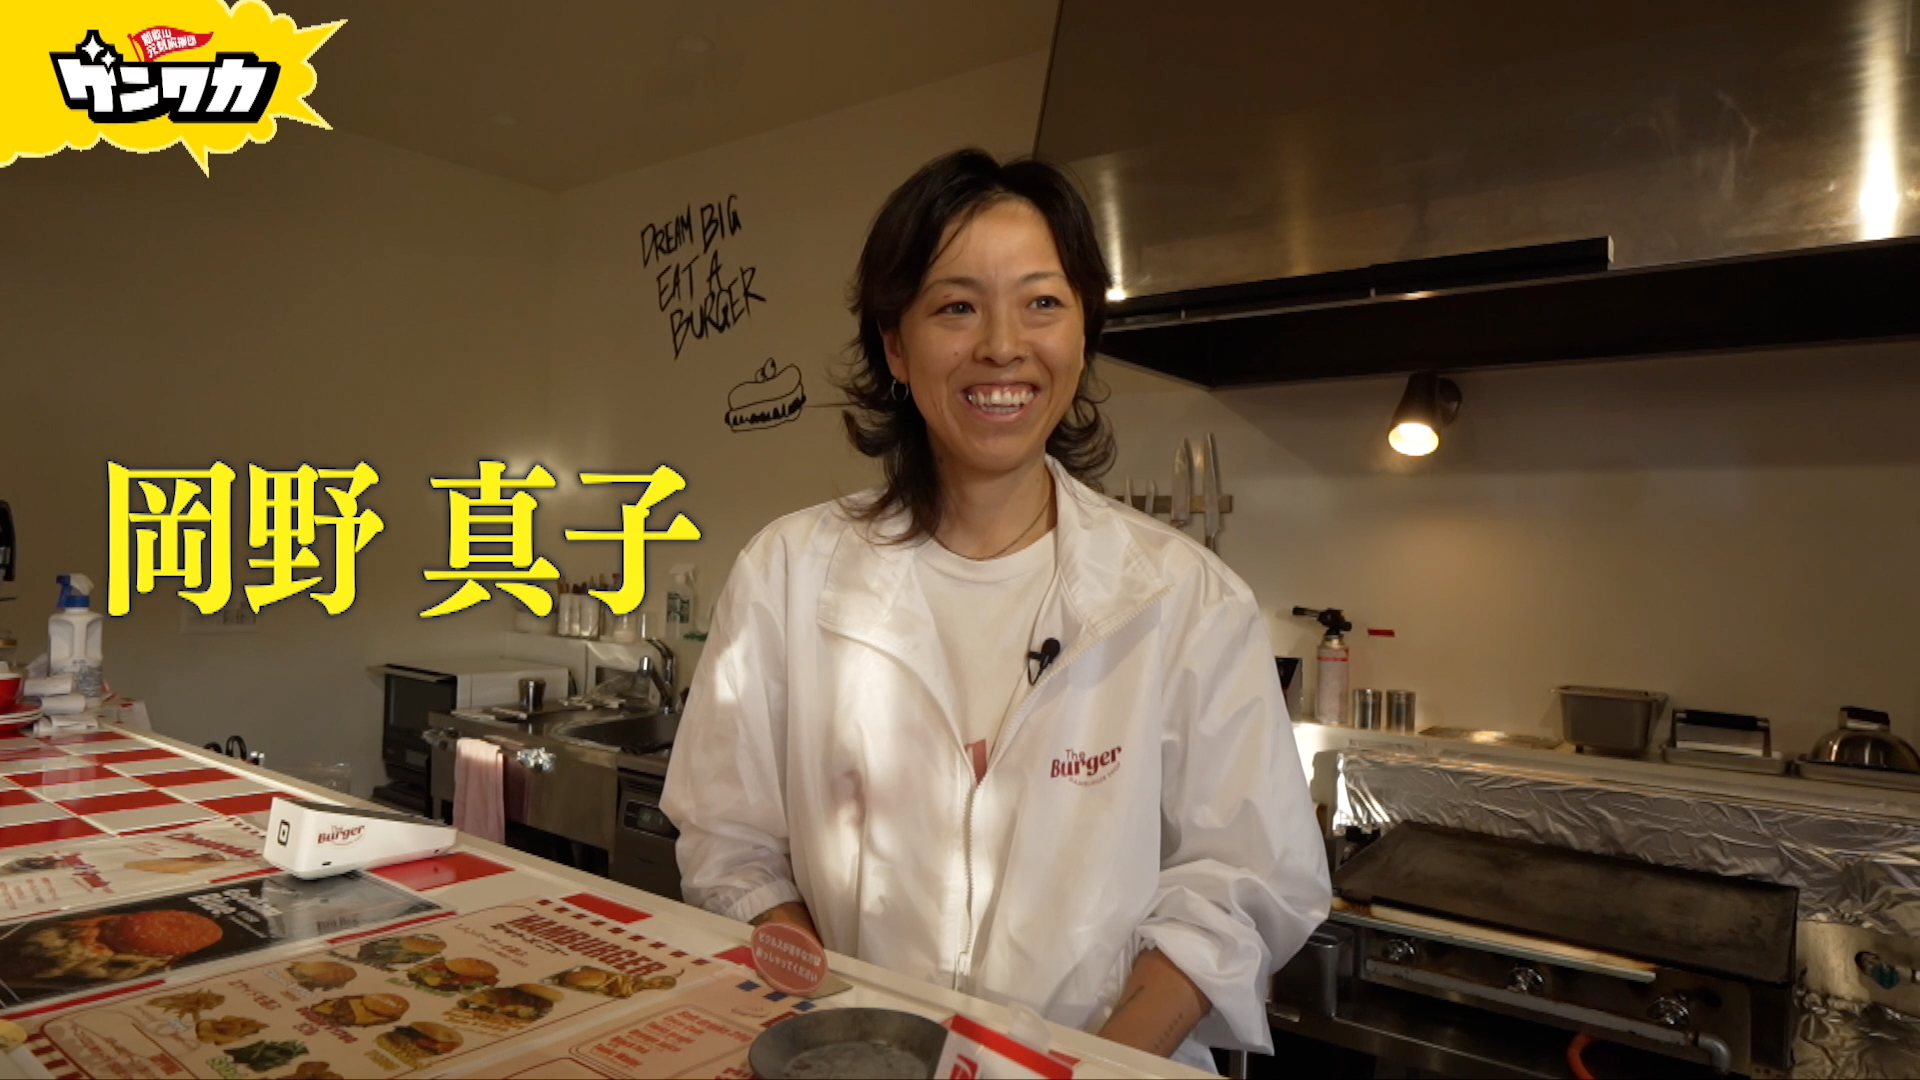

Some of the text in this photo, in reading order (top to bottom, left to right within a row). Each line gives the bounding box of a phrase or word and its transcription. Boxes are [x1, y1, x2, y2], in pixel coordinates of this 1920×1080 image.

[641, 194, 742, 268] DREAM BIG
[656, 249, 723, 312] EAT A
[670, 266, 767, 360] BURGER
[1050, 745, 1122, 778] Burger
[1065, 748, 1086, 763] The
[317, 825, 365, 844] Burger
[505, 913, 668, 978] HAMBURGER
